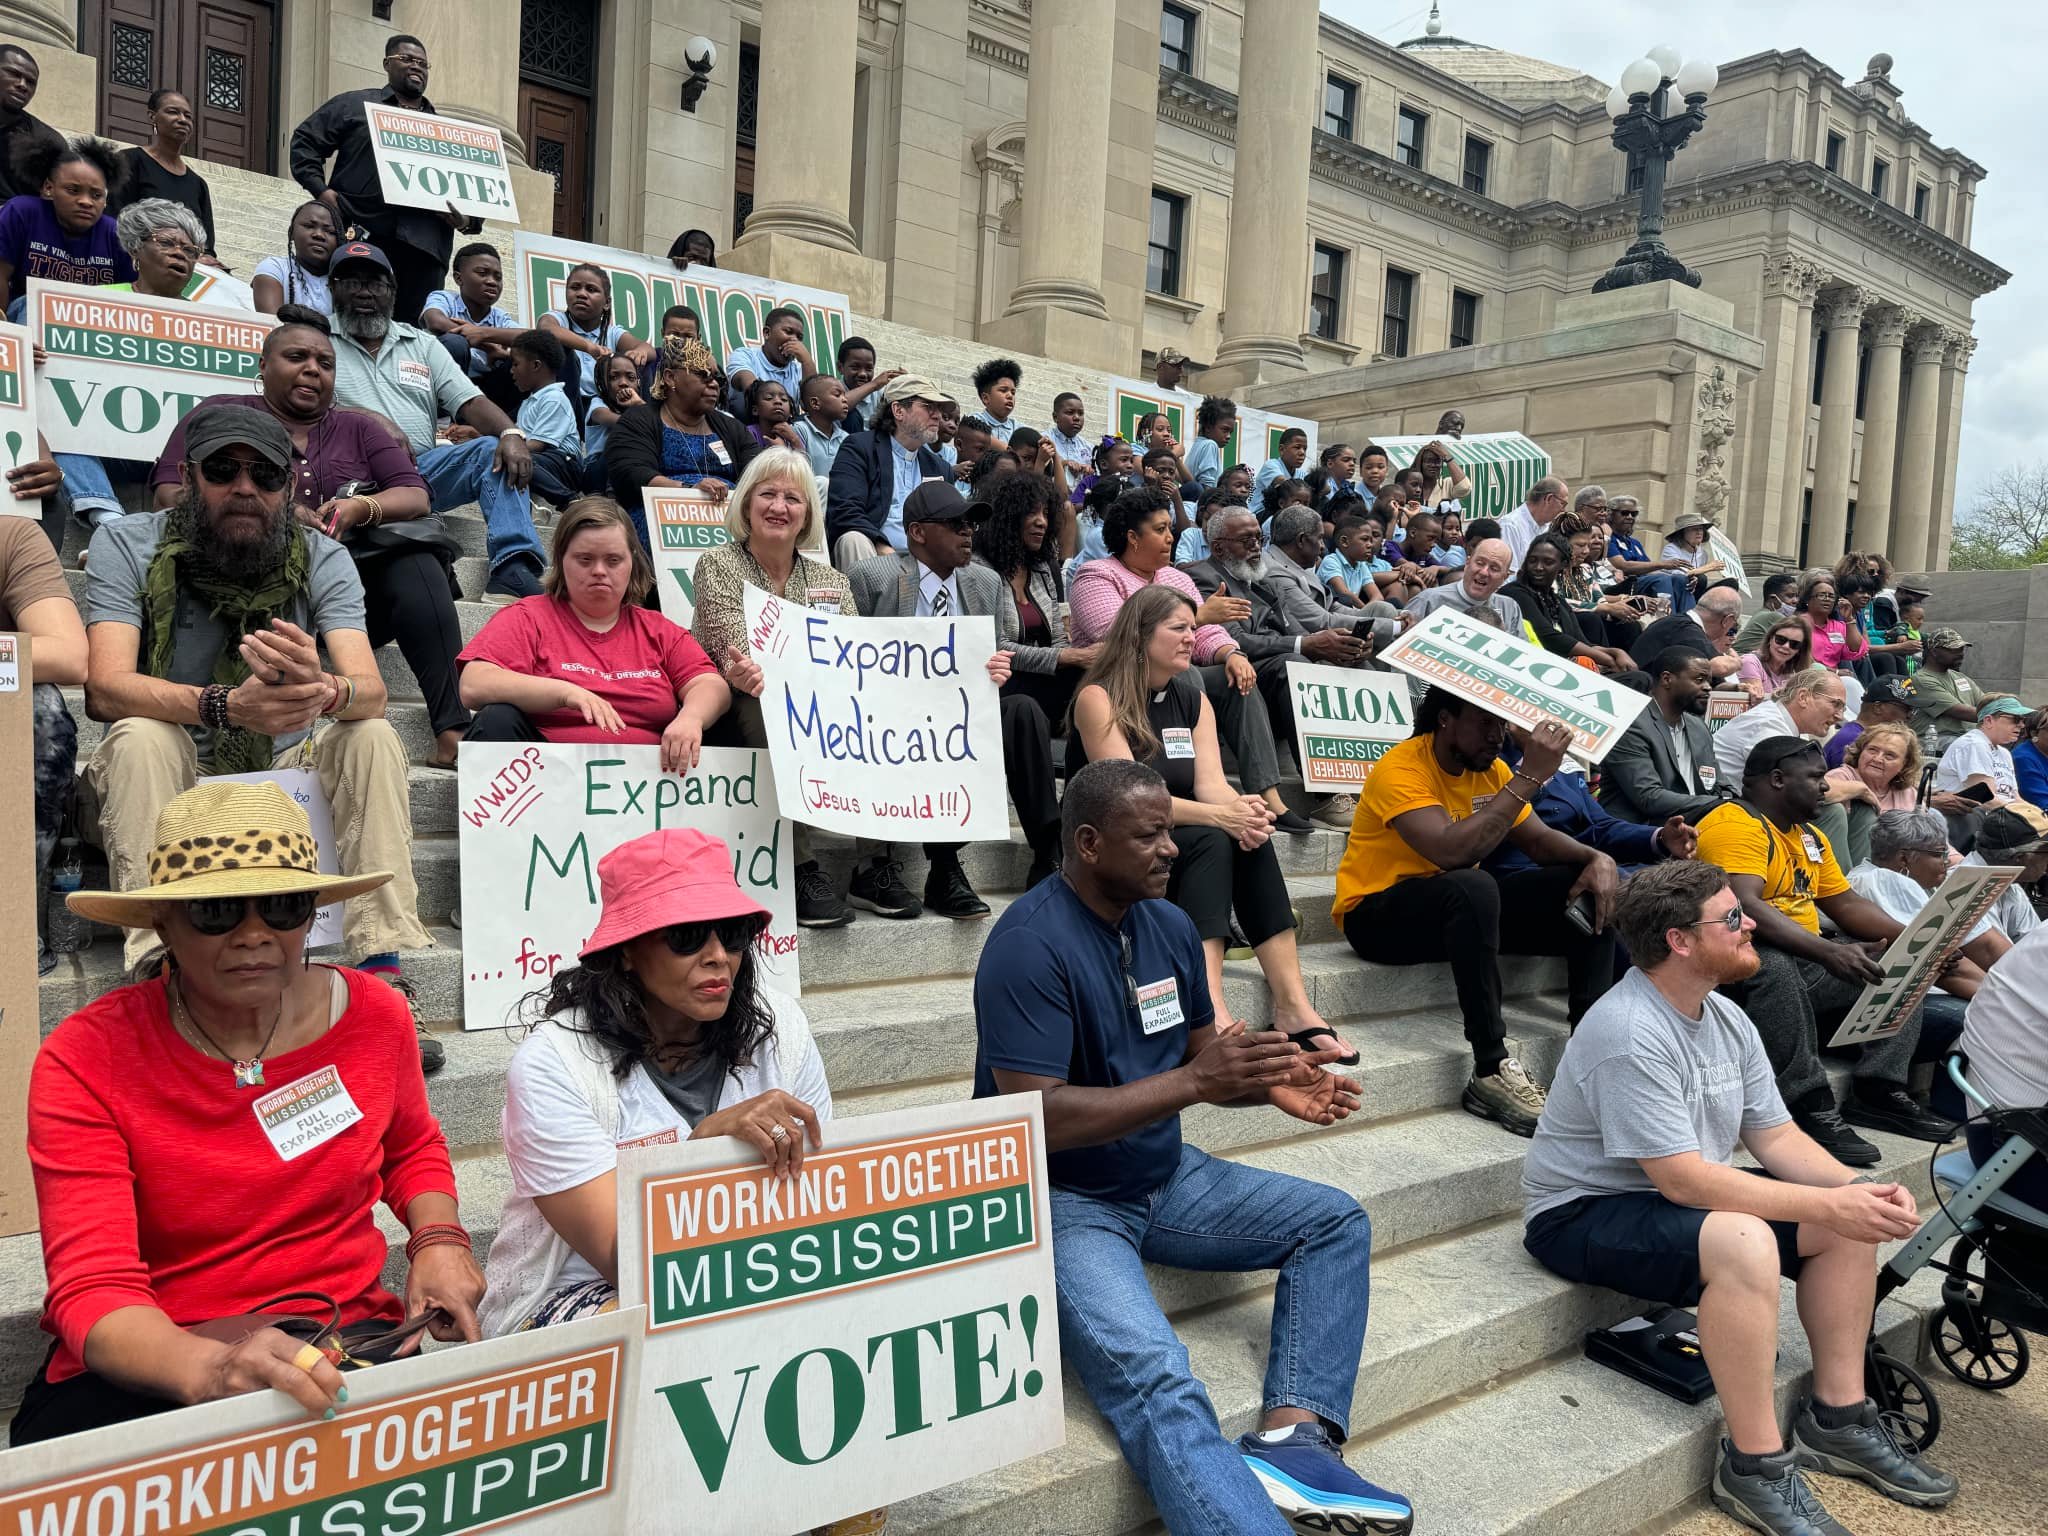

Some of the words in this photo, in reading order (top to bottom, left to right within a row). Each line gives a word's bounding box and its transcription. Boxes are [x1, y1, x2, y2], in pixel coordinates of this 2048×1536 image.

[380, 115, 436, 137] WORKING
[438, 126, 494, 149] TOGETHER
[382, 132, 499, 165] MISSISSIPPI
[385, 160, 511, 208] VOTE!
[30, 241, 49, 252] NEW
[51, 300, 154, 335] WORKING
[161, 316, 263, 349] TOGETHER
[51, 328, 255, 373] MISSISSIPP
[44, 377, 205, 434] VOT
[750, 595, 784, 652] WWJD?
[806, 617, 959, 691] Expand
[1403, 652, 1496, 700] TOGETHER
[1429, 617, 1620, 718] VOTE!
[1297, 682, 1409, 726] VOTE!
[1412, 641, 1601, 734] MISSISSIPPI
[1713, 703, 1744, 716] WORKING
[784, 681, 978, 765] Medicaid
[1500, 695, 1590, 746] WKING
[1309, 740, 1392, 760] SISSIPPI
[1312, 761, 1367, 780] TOGETHER
[462, 747, 545, 828] WWJD?
[585, 752, 759, 831] Expand
[800, 765, 861, 815] (Jesus
[515, 937, 562, 980] for
[1144, 1011, 1181, 1030] EXPANSION
[1155, 1006, 1171, 1017] FULL
[260, 1089, 297, 1114] WORKING
[295, 1071, 334, 1097] TOGETHER
[264, 1082, 340, 1129] MISSISSIPPI
[280, 1107, 357, 1153] EXPANSION
[296, 1109, 329, 1131] FULL
[643, 1131, 676, 1147] TOGETHER
[665, 1165, 847, 1241] WORKING
[858, 1136, 1020, 1207] TOGETHER
[665, 1192, 1025, 1310] MISSISSIPPI
[654, 1294, 1044, 1494] VOTE!
[17, 1436, 318, 1536] WORKING
[340, 1366, 598, 1481] TOGETHER
[229, 1433, 593, 1536] SSIPPI
